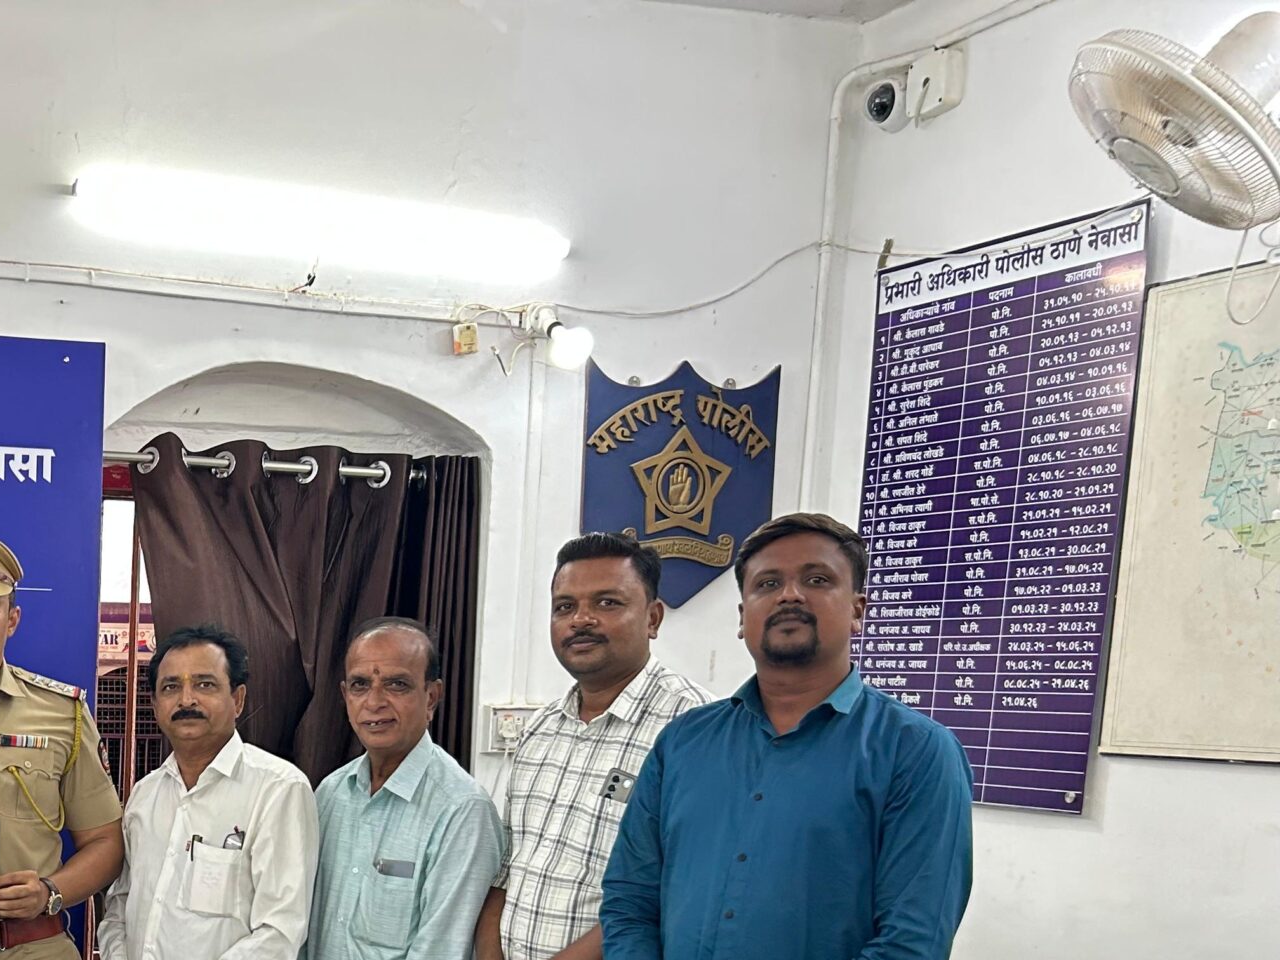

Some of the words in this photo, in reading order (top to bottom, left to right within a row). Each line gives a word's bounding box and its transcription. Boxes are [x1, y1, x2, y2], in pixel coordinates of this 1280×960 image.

[885, 272, 922, 304] प्रभारी
[927, 254, 990, 291] अधिकारी
[995, 243, 1045, 274] पोलीस
[1051, 230, 1083, 260] ठाणे
[1088, 221, 1140, 250] नेवासा
[988, 287, 1014, 301] पदनाम
[1065, 262, 1102, 282] कालावधी
[881, 336, 885, 345] १
[879, 354, 884, 363] २
[878, 371, 882, 381] ३
[876, 389, 882, 397] ४
[875, 406, 880, 415] ५
[586, 389, 686, 454] महाराष्ट्र
[695, 386, 771, 460] पोलीस
[873, 423, 878, 432] ६
[872, 441, 877, 449] ७
[870, 458, 875, 466] ८
[869, 475, 874, 484] ९
[866, 492, 875, 501] १०
[864, 509, 873, 518] ११
[862, 526, 872, 535] १२
[99, 633, 119, 645] AR
[851, 643, 860, 652] १९
